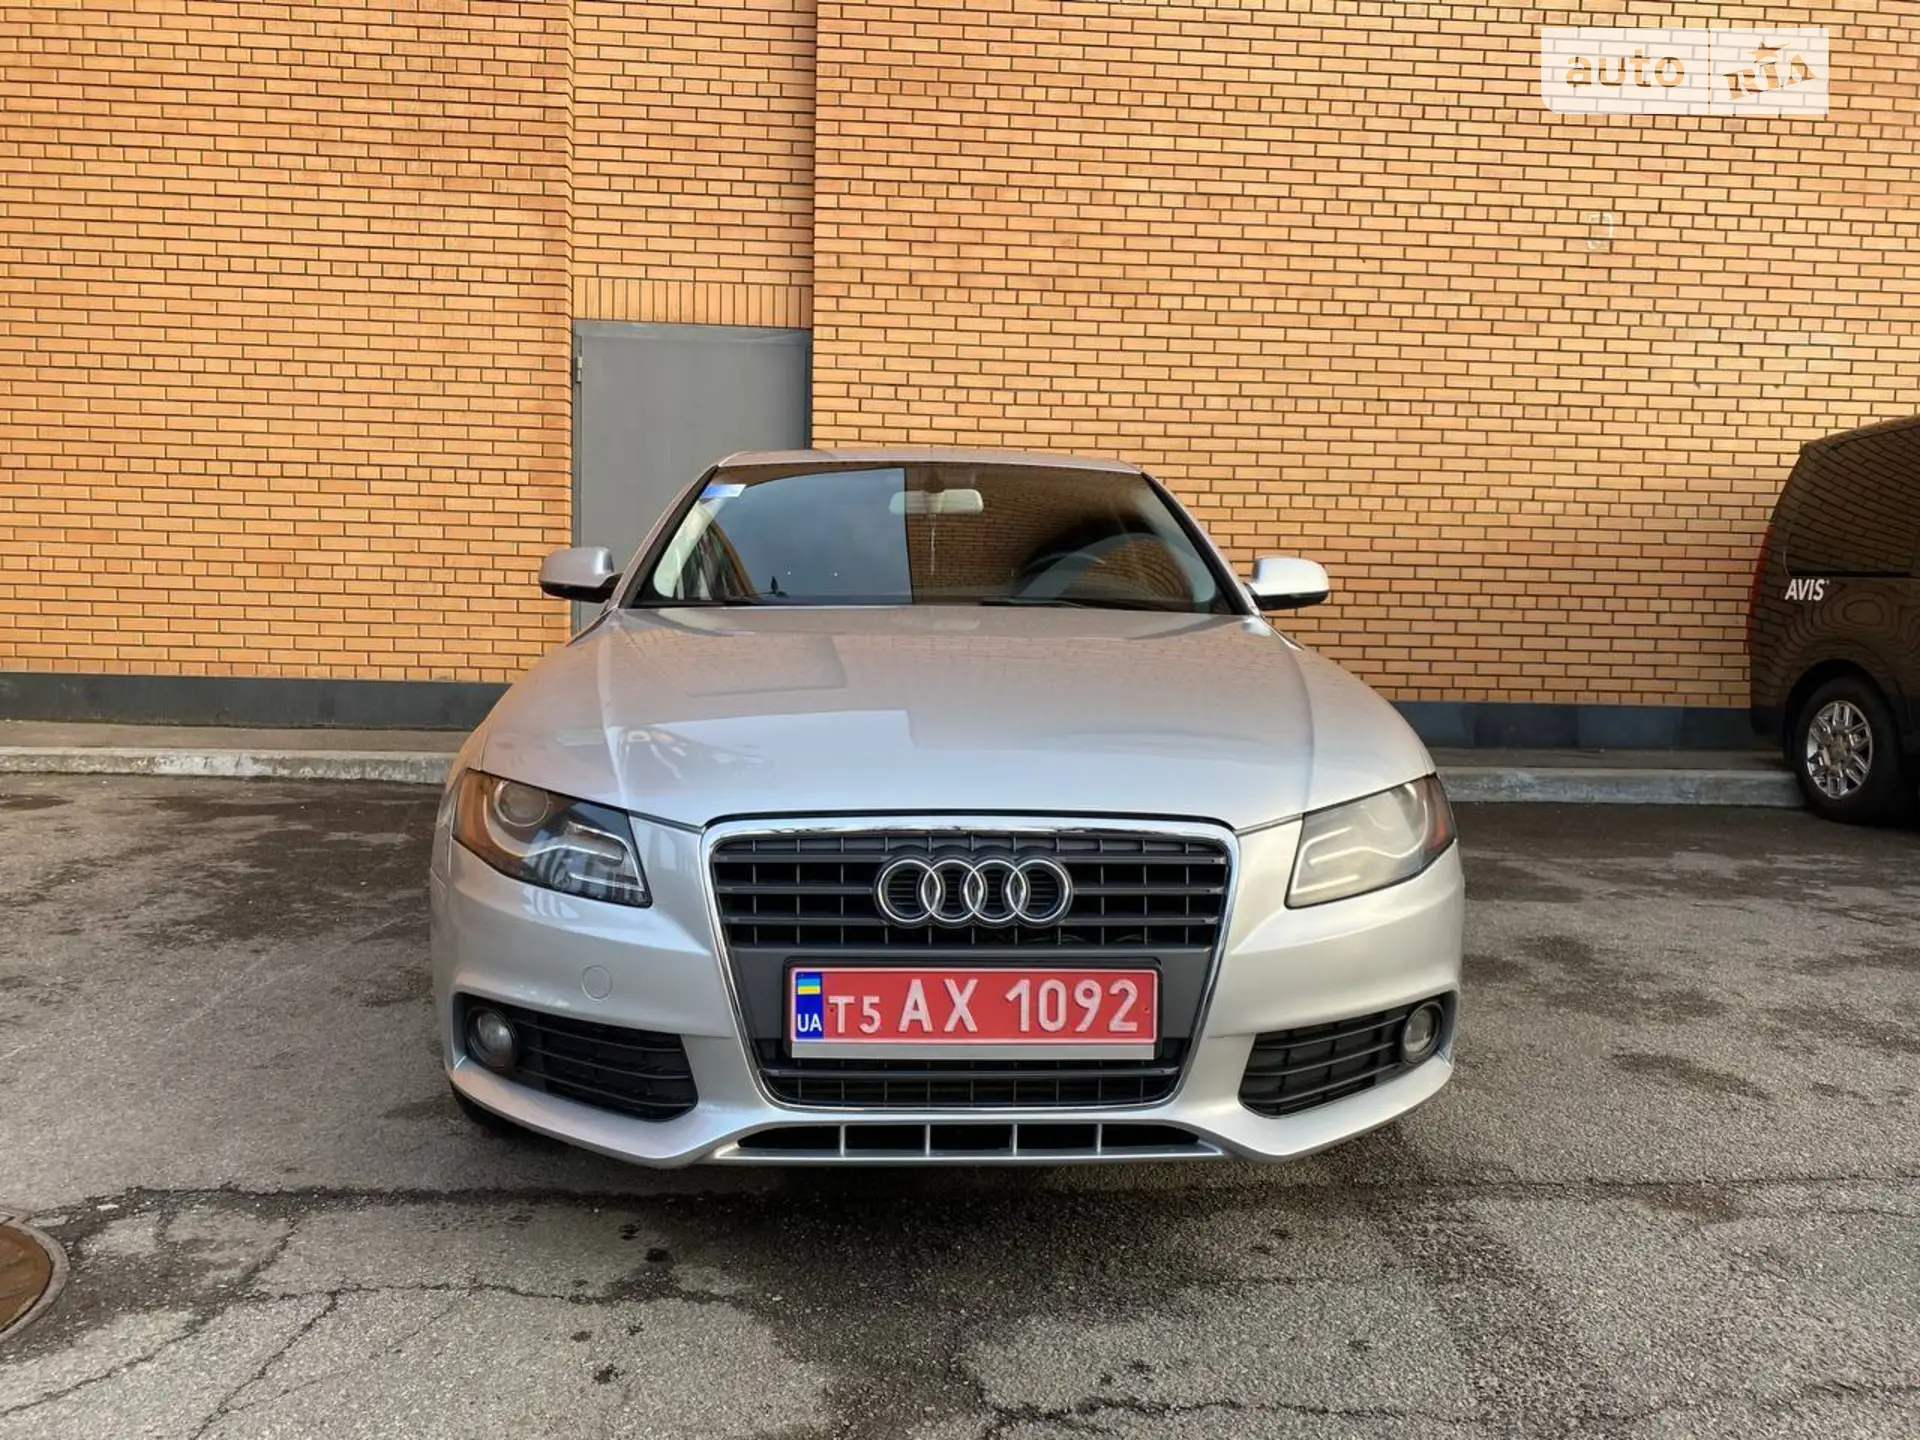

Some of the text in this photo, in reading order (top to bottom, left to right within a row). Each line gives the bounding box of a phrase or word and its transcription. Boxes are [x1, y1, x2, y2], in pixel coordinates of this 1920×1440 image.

[1784, 578, 1825, 601] AVIS
[828, 978, 1139, 1034] T5 AX 1092
[797, 1013, 822, 1032] UA
